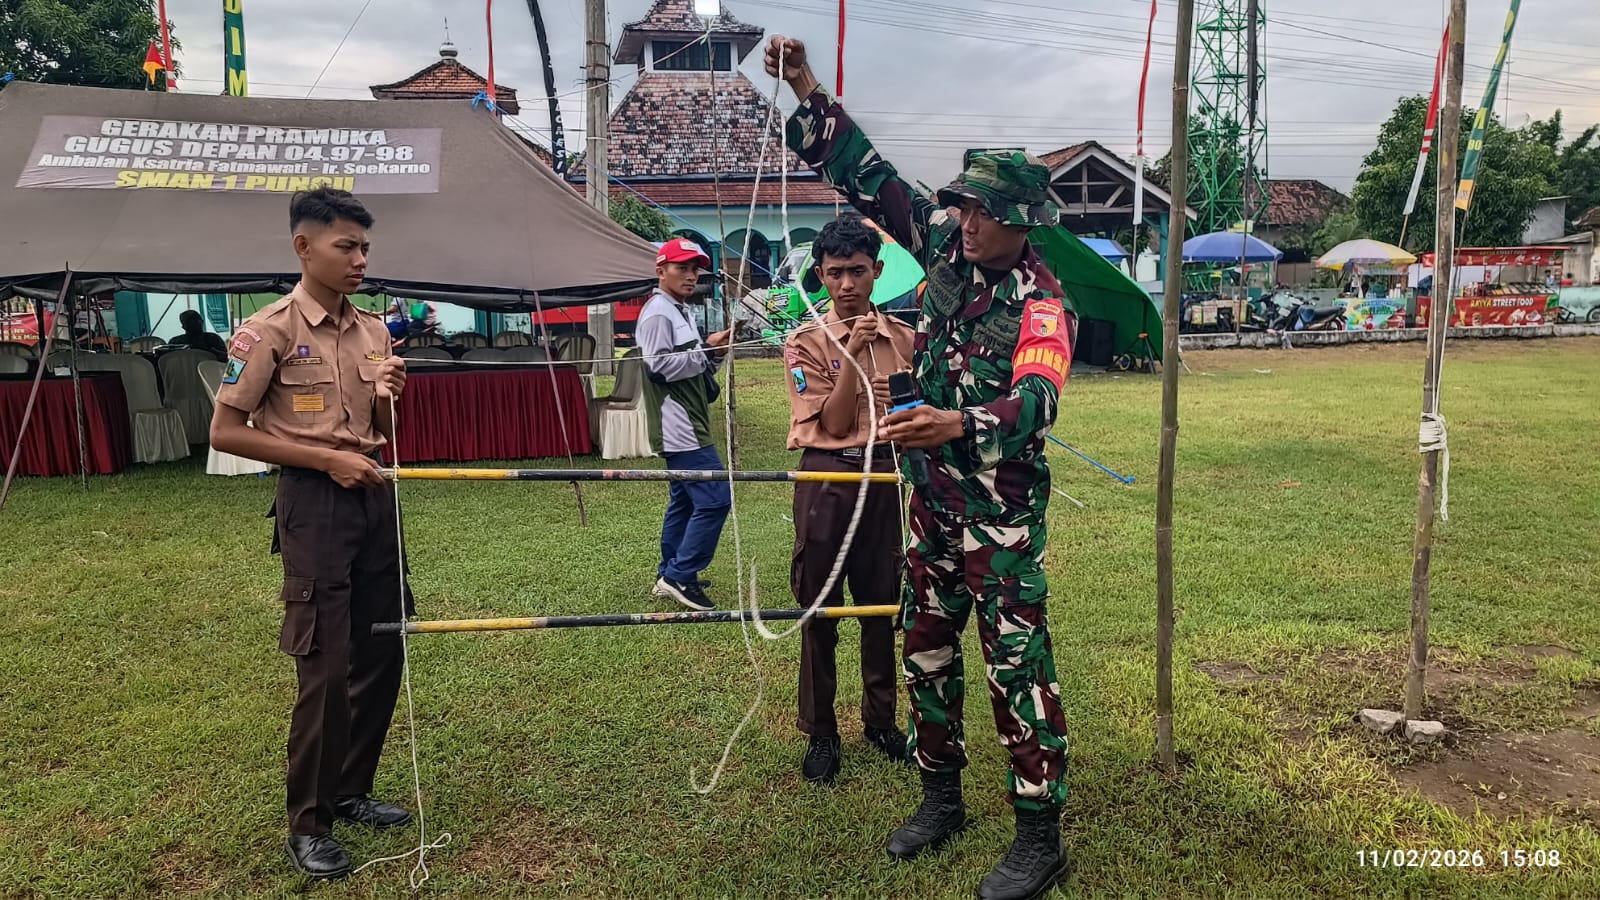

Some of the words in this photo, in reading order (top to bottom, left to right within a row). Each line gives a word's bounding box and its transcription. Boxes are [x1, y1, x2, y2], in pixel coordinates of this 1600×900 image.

[101, 119, 240, 142] GERAKAN
[246, 126, 387, 145] PRAMUKA
[64, 136, 173, 157] GUGUS
[180, 141, 277, 160] DEPAN
[284, 145, 413, 162] 04.97-98
[38, 154, 129, 168] Ambalan
[132, 157, 204, 171] Ksatria
[208, 160, 308, 174] Fatmawati
[322, 162, 340, 175] Ir.
[343, 162, 431, 175] Soekarno
[115, 171, 214, 190] SMAN
[223, 175, 237, 190] 1
[244, 175, 355, 192] PUNCU
[1492, 298, 1516, 307] STREET
[1516, 297, 1534, 307] FOOD
